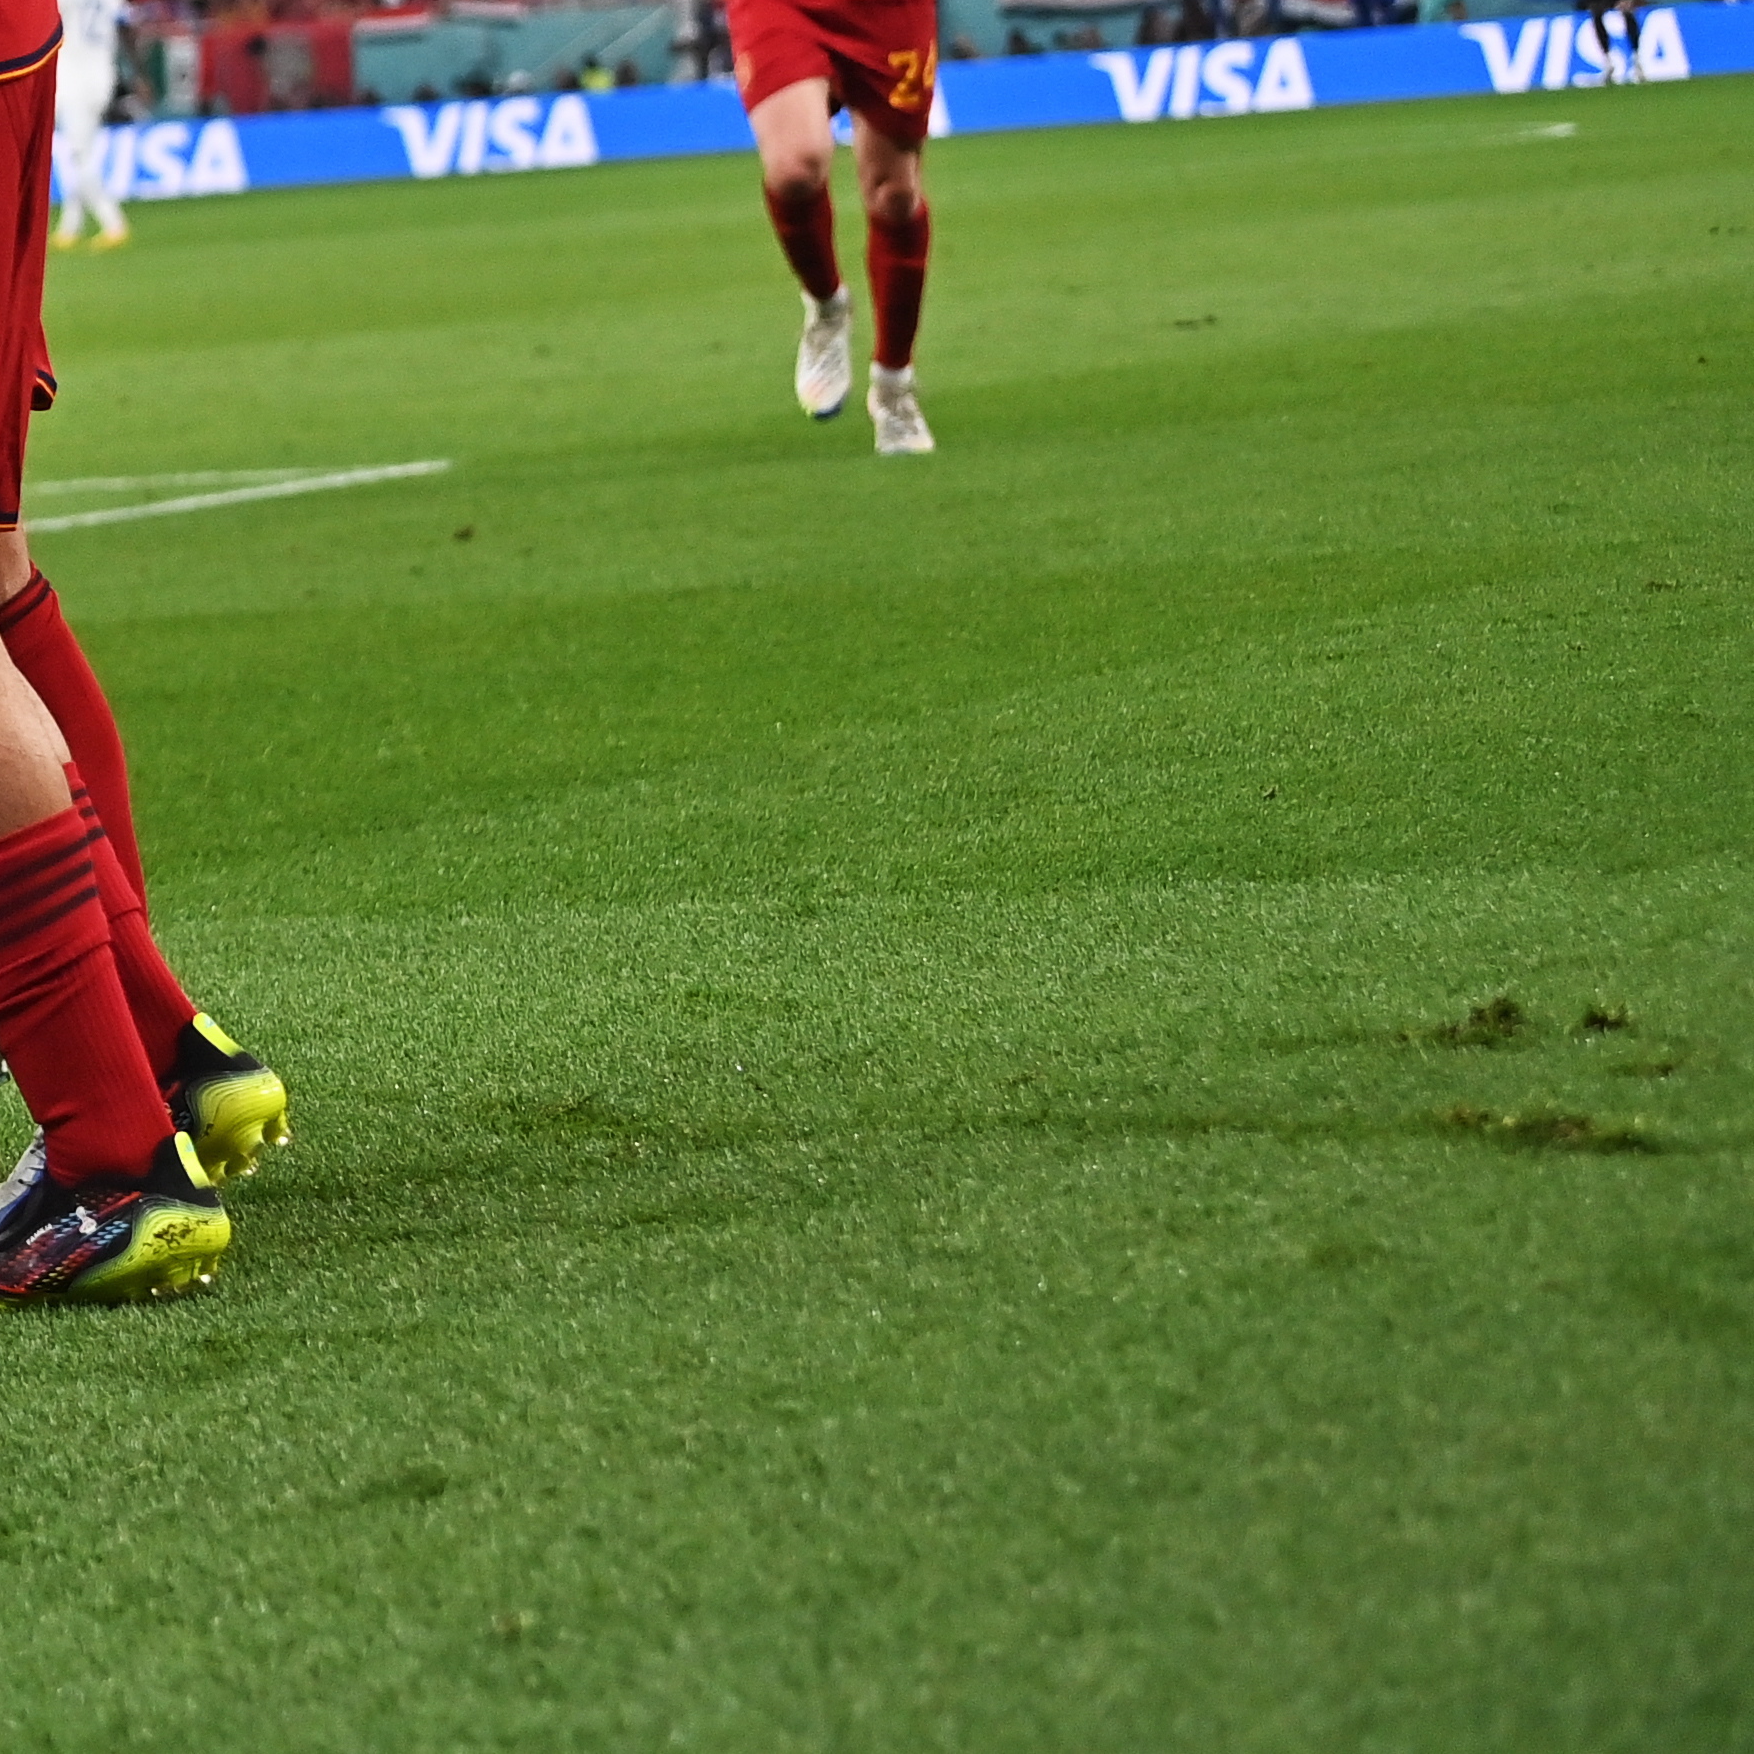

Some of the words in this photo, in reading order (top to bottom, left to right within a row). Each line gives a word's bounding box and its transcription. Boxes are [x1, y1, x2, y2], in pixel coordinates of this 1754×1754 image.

[1096, 39, 1315, 124] VISA
[1460, 9, 1692, 96] VISA
[376, 96, 599, 180] VISA
